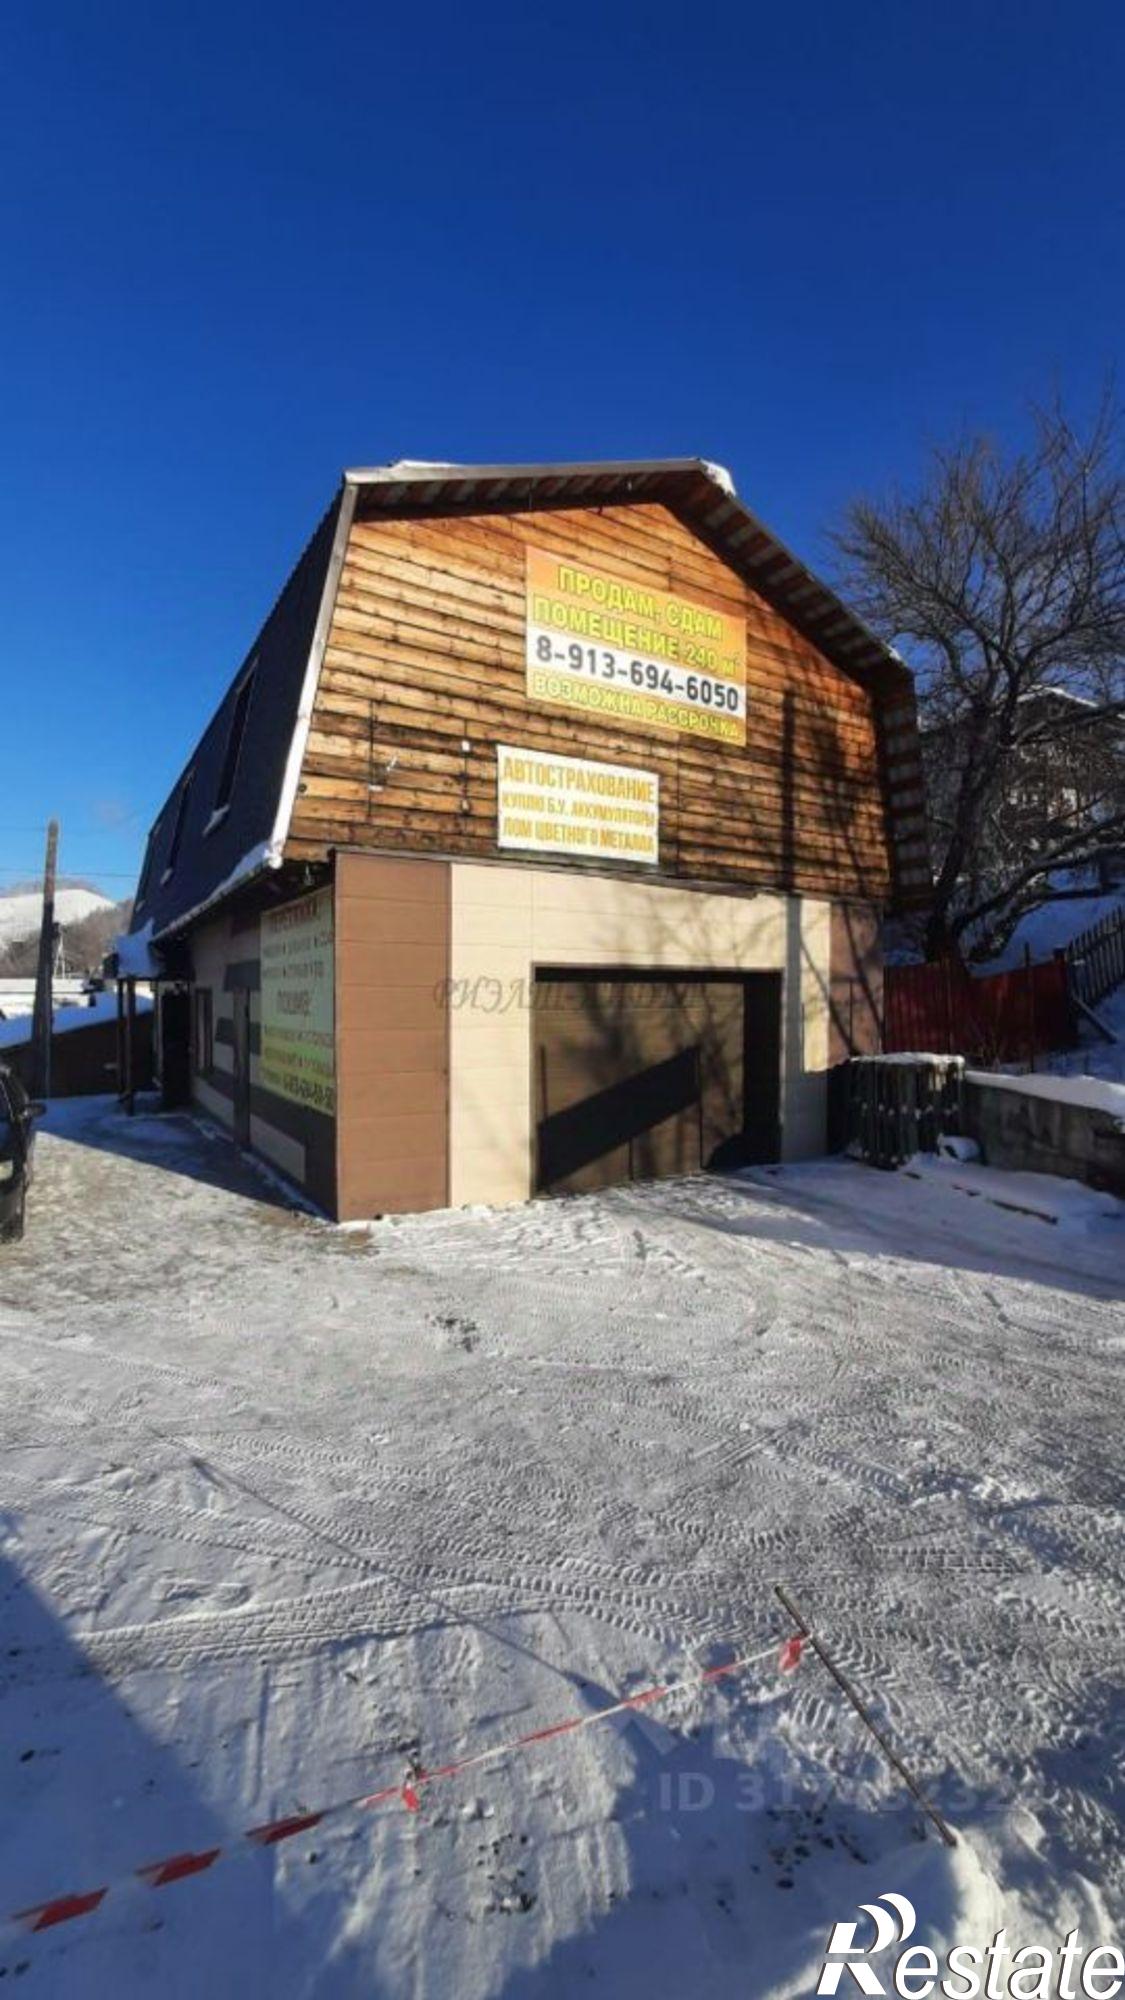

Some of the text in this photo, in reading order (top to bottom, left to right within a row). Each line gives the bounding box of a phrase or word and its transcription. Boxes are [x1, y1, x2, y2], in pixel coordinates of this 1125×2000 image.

[533, 593, 680, 660] ПОМЕЩЕНИЕ
[686, 642, 717, 669] 240
[666, 602, 723, 640] СДАМ
[536, 634, 739, 712] 8-913-694-6050
[533, 671, 741, 738] ВОЗМОЖНА РАССРОЧКА
[503, 756, 655, 803] АВТОСТРАХОВАНИЕ
[503, 816, 533, 838] ЛОМ
